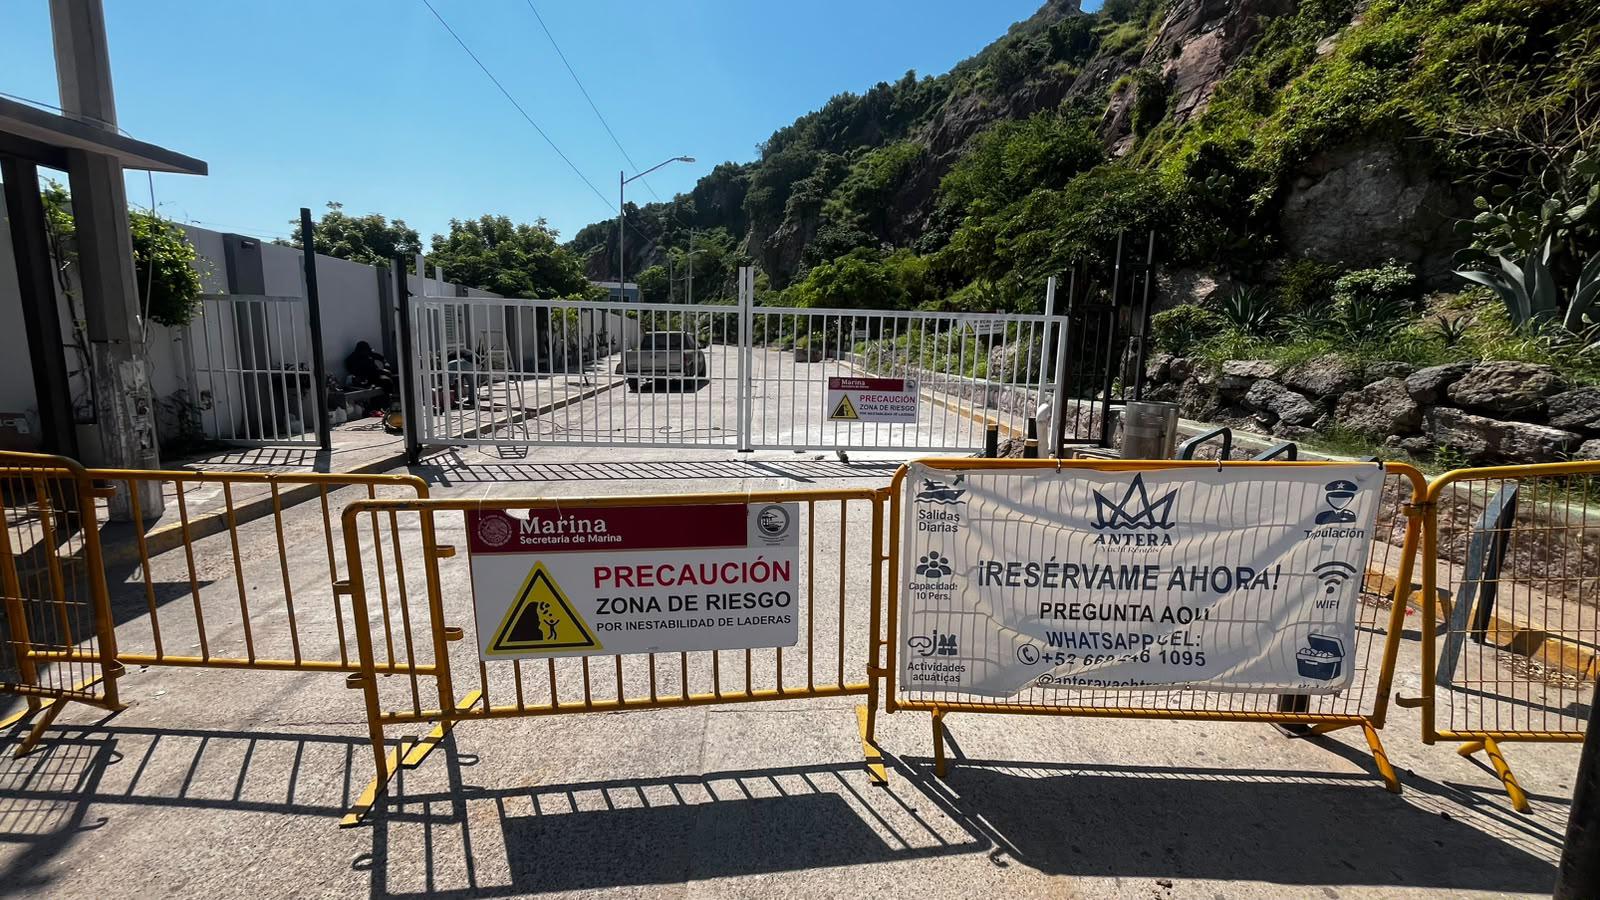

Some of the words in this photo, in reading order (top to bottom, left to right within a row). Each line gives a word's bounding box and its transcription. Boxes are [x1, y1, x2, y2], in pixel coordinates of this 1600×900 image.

[859, 394, 916, 404] PRECAUCIÓN
[919, 509, 960, 522] Salidas
[520, 515, 607, 534] Marina
[919, 521, 958, 532] Diarias
[572, 534, 586, 542] de
[588, 533, 622, 542] Marina
[1094, 533, 1172, 546] ANTERA
[1304, 528, 1365, 540] Tpulación
[593, 555, 791, 588] PRECAUCIÓN
[1167, 564, 1281, 593] AHORA!
[908, 582, 958, 592] Capacidad:
[916, 592, 927, 600] 10
[928, 592, 951, 600] Pers.
[596, 596, 661, 615] ZONA
[668, 595, 698, 613] DE
[706, 591, 791, 610] RIESGO
[1316, 600, 1340, 609] WIFI
[1040, 602, 1154, 622] PREGUNTA
[596, 622, 622, 631] POR
[625, 617, 715, 630] INESTABILIDAD
[718, 617, 733, 626] DE
[737, 615, 791, 626] LADERAS
[1045, 631, 1154, 650] WHATSAPP
[1042, 651, 1076, 666] +52
[1158, 651, 1206, 666] 1095
[907, 661, 966, 672] Actividades
[912, 673, 960, 684] acuáticas
